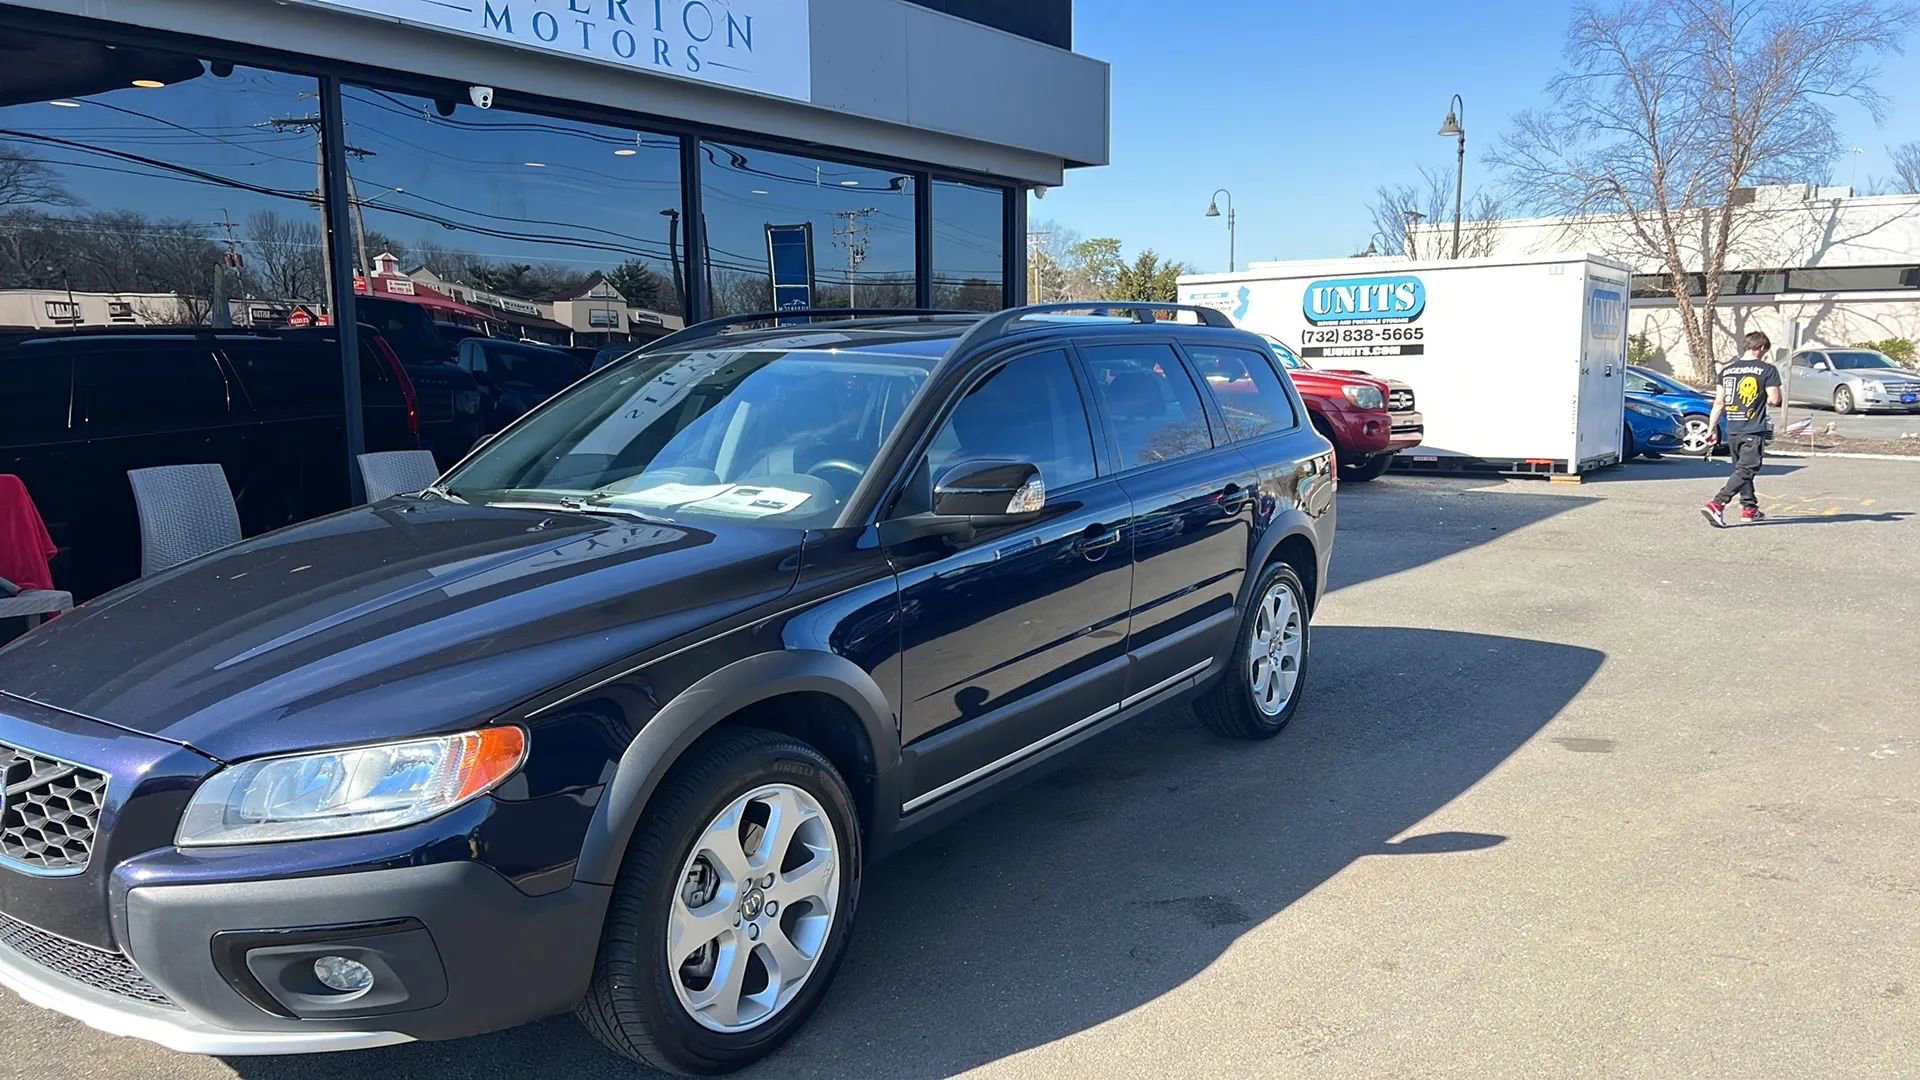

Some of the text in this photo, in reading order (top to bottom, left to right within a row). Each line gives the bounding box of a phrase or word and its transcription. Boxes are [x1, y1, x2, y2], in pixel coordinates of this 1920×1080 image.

[483, 0, 700, 73] MOTORS
[1311, 281, 1416, 315] UNITS
[1301, 327, 1424, 345] (732) 838-5665
[772, 761, 815, 777] PIRELLI
